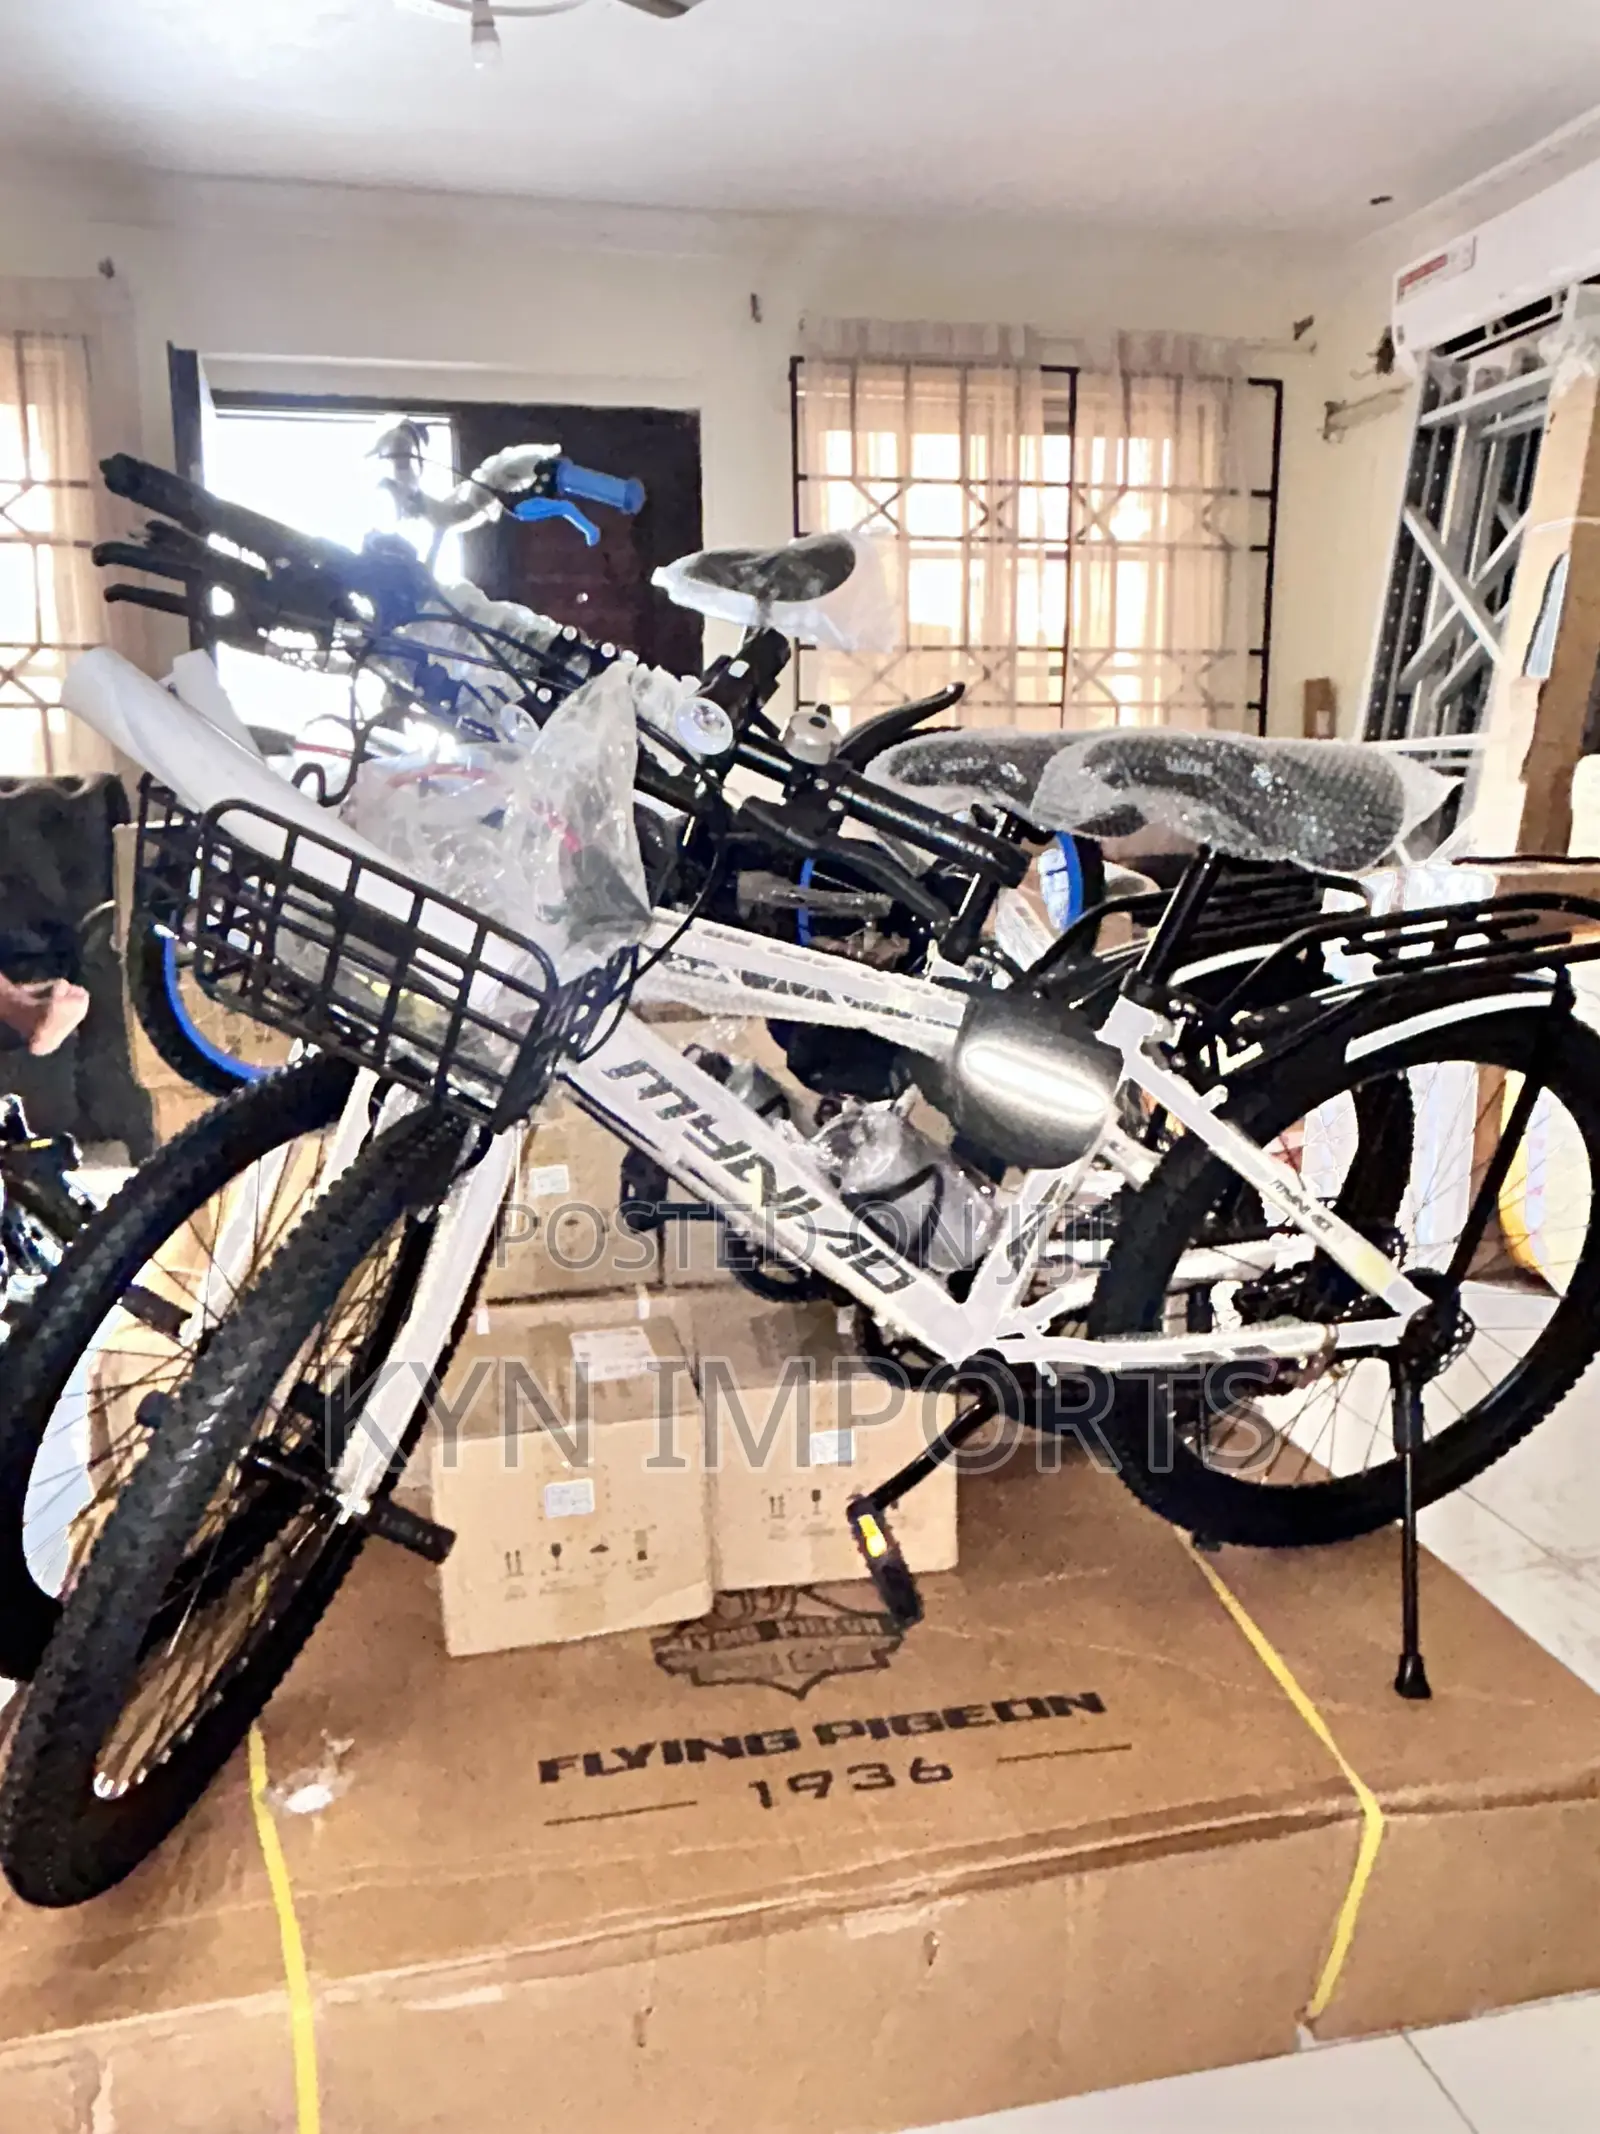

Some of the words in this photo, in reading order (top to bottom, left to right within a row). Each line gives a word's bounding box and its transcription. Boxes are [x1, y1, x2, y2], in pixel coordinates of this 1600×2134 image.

[538, 1726, 801, 1784] FLYING
[814, 1691, 1107, 1742] PIGEON
[748, 1757, 955, 1808] 1936
